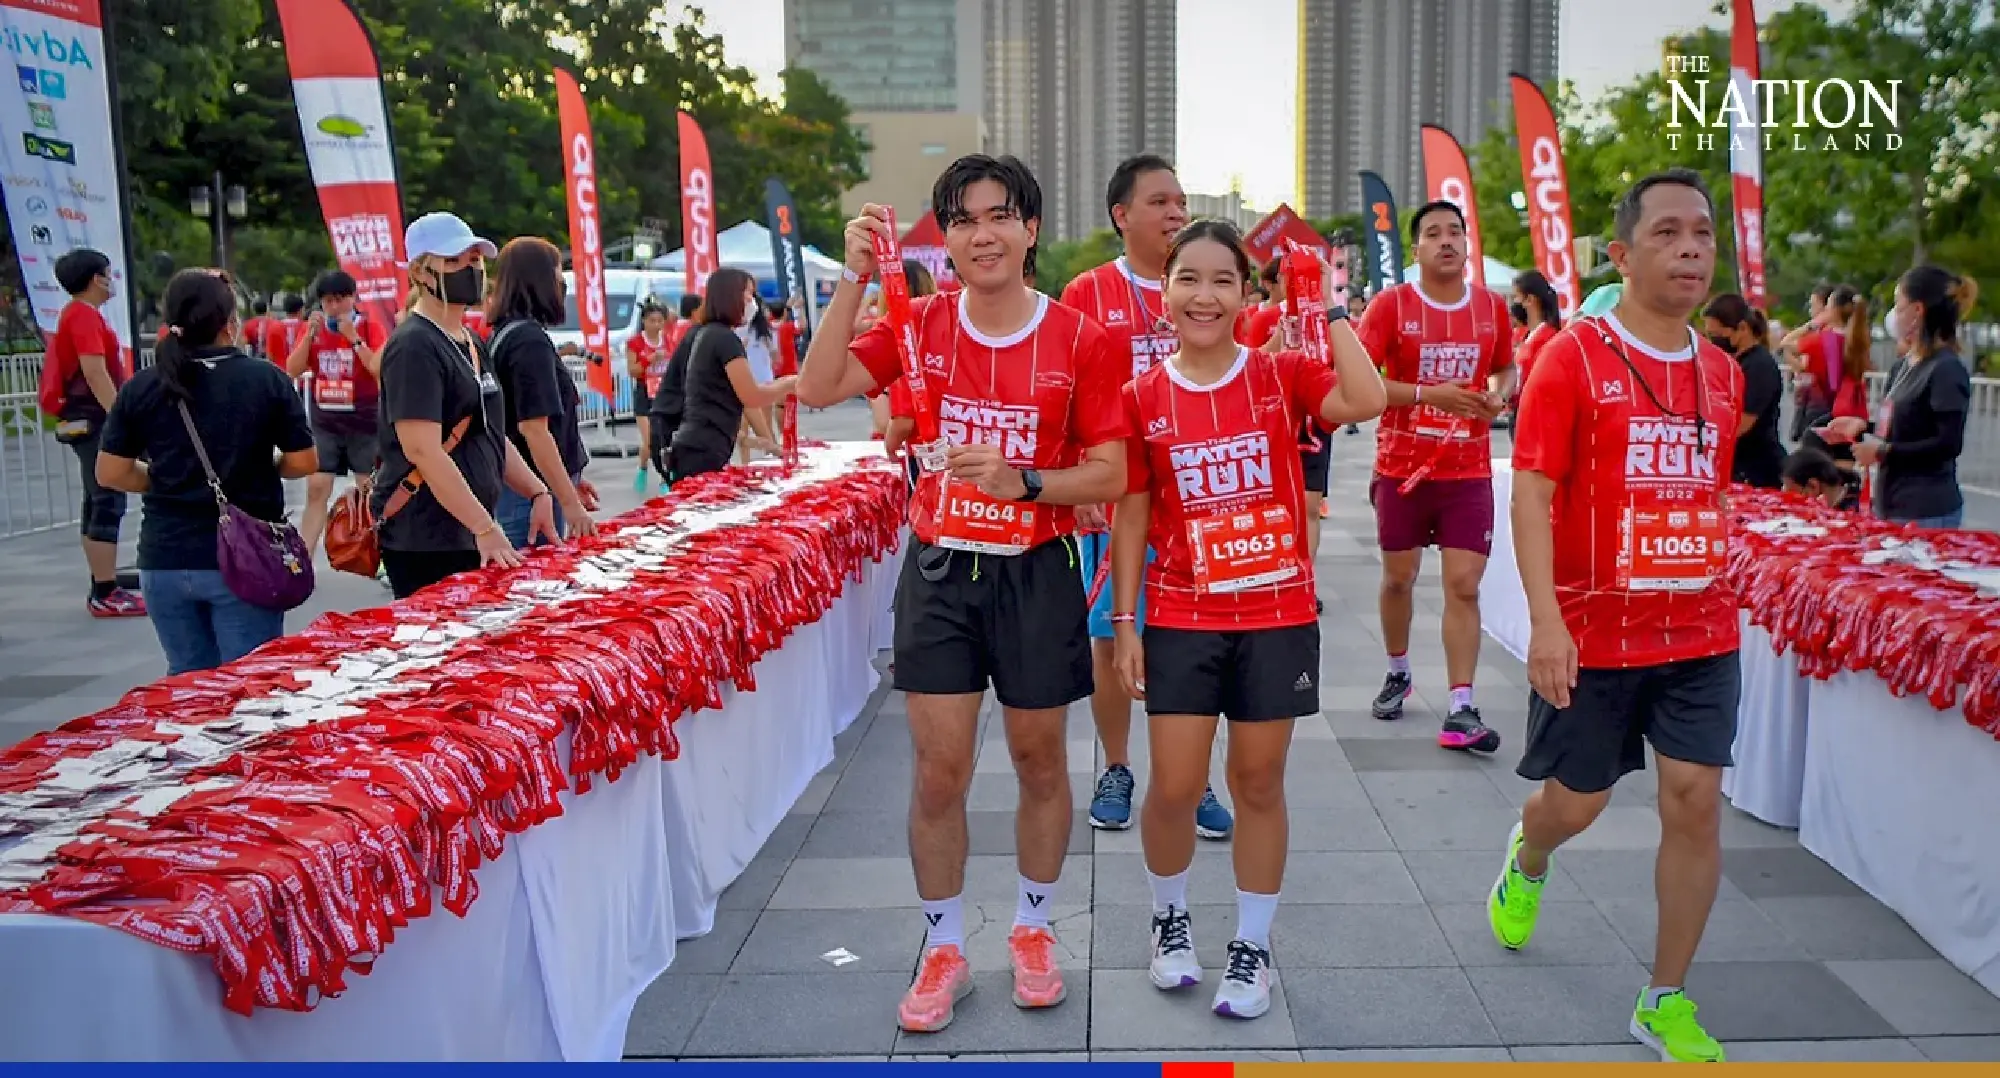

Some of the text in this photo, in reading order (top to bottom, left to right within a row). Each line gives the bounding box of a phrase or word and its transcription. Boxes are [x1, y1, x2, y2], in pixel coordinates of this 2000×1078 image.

[1420, 347, 1480, 359] MATCH
[1419, 359, 1478, 378] RUN
[940, 399, 1040, 432] MATCH
[1629, 422, 1718, 448] MATCH
[1170, 436, 1270, 470] MATCH
[1626, 444, 1716, 478] RUN
[1175, 456, 1273, 501] RUN
[1656, 490, 1694, 499] 2022
[949, 497, 1017, 523] L1964
[1211, 533, 1276, 560] L1963
[1640, 535, 1707, 557] L1063
